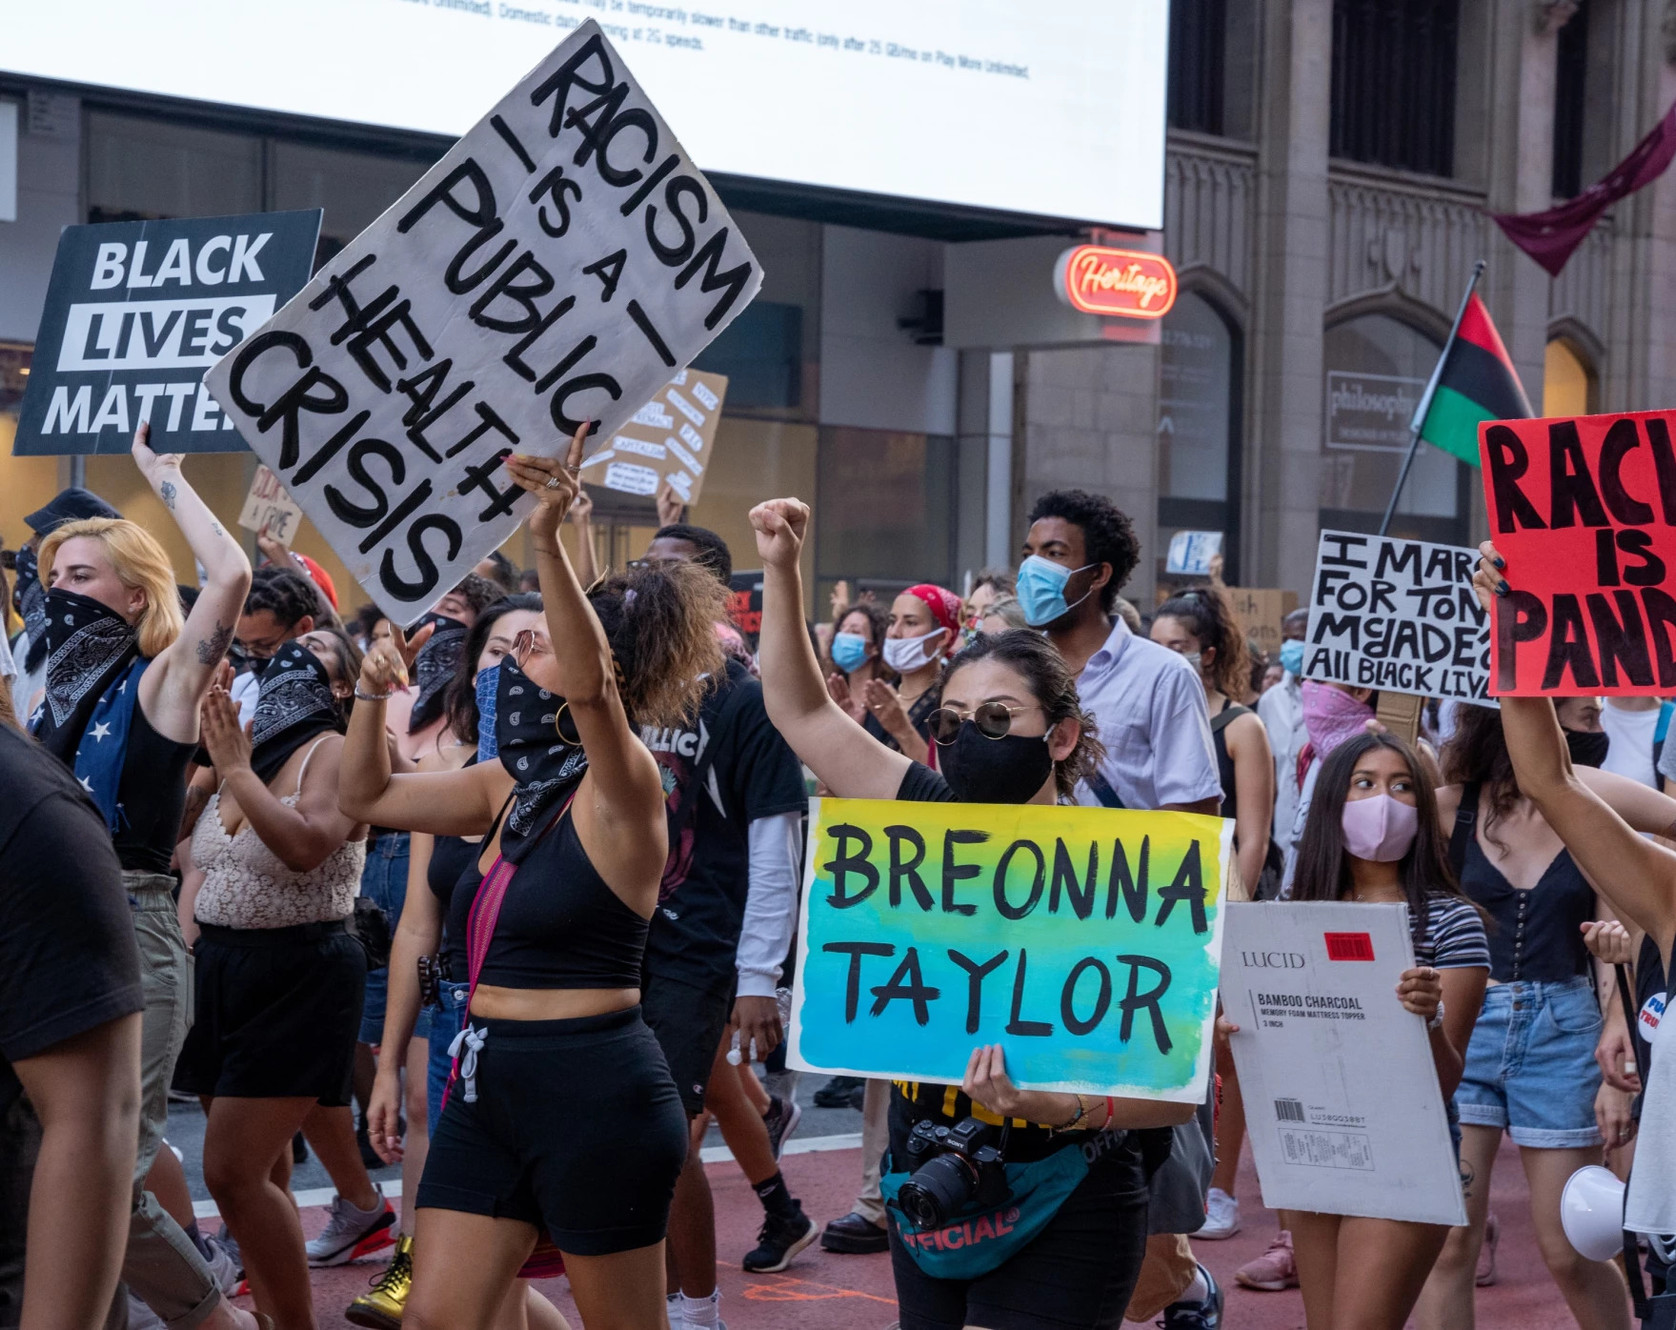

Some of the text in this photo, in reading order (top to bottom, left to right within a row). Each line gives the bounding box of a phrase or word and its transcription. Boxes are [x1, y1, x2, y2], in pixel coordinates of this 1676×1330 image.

[499, 2, 551, 26] Domestic
[627, 1, 687, 25] temporarily
[691, 11, 724, 27] slower
[729, 15, 751, 32] than
[755, 21, 779, 37] other
[784, 26, 813, 43] traffic
[844, 36, 865, 51] after
[531, 33, 752, 330] RACISM
[90, 232, 274, 290] BLACK
[529, 166, 627, 302] IS A
[397, 156, 623, 438] PUBLIC
[1081, 255, 1168, 308] Heritage
[82, 306, 248, 361] LIVES
[309, 253, 518, 522] HEALTH
[229, 330, 462, 602] CRISIS
[1322, 534, 1368, 569] I
[1596, 528, 1667, 587] IS
[1317, 569, 1397, 614] FOR
[1497, 587, 1676, 692] PAND
[1358, 657, 1433, 693] BLACK
[822, 822, 1209, 935] BREONNA
[1242, 951, 1305, 969] LUCID
[822, 941, 1173, 1056] TAYLOR
[1258, 993, 1362, 1010] BAMBOO CHARCOAL
[1261, 1008, 1366, 1020] MEMORY FOAM MATTRESS TOPPER
[1269, 1020, 1284, 1028] INCH
